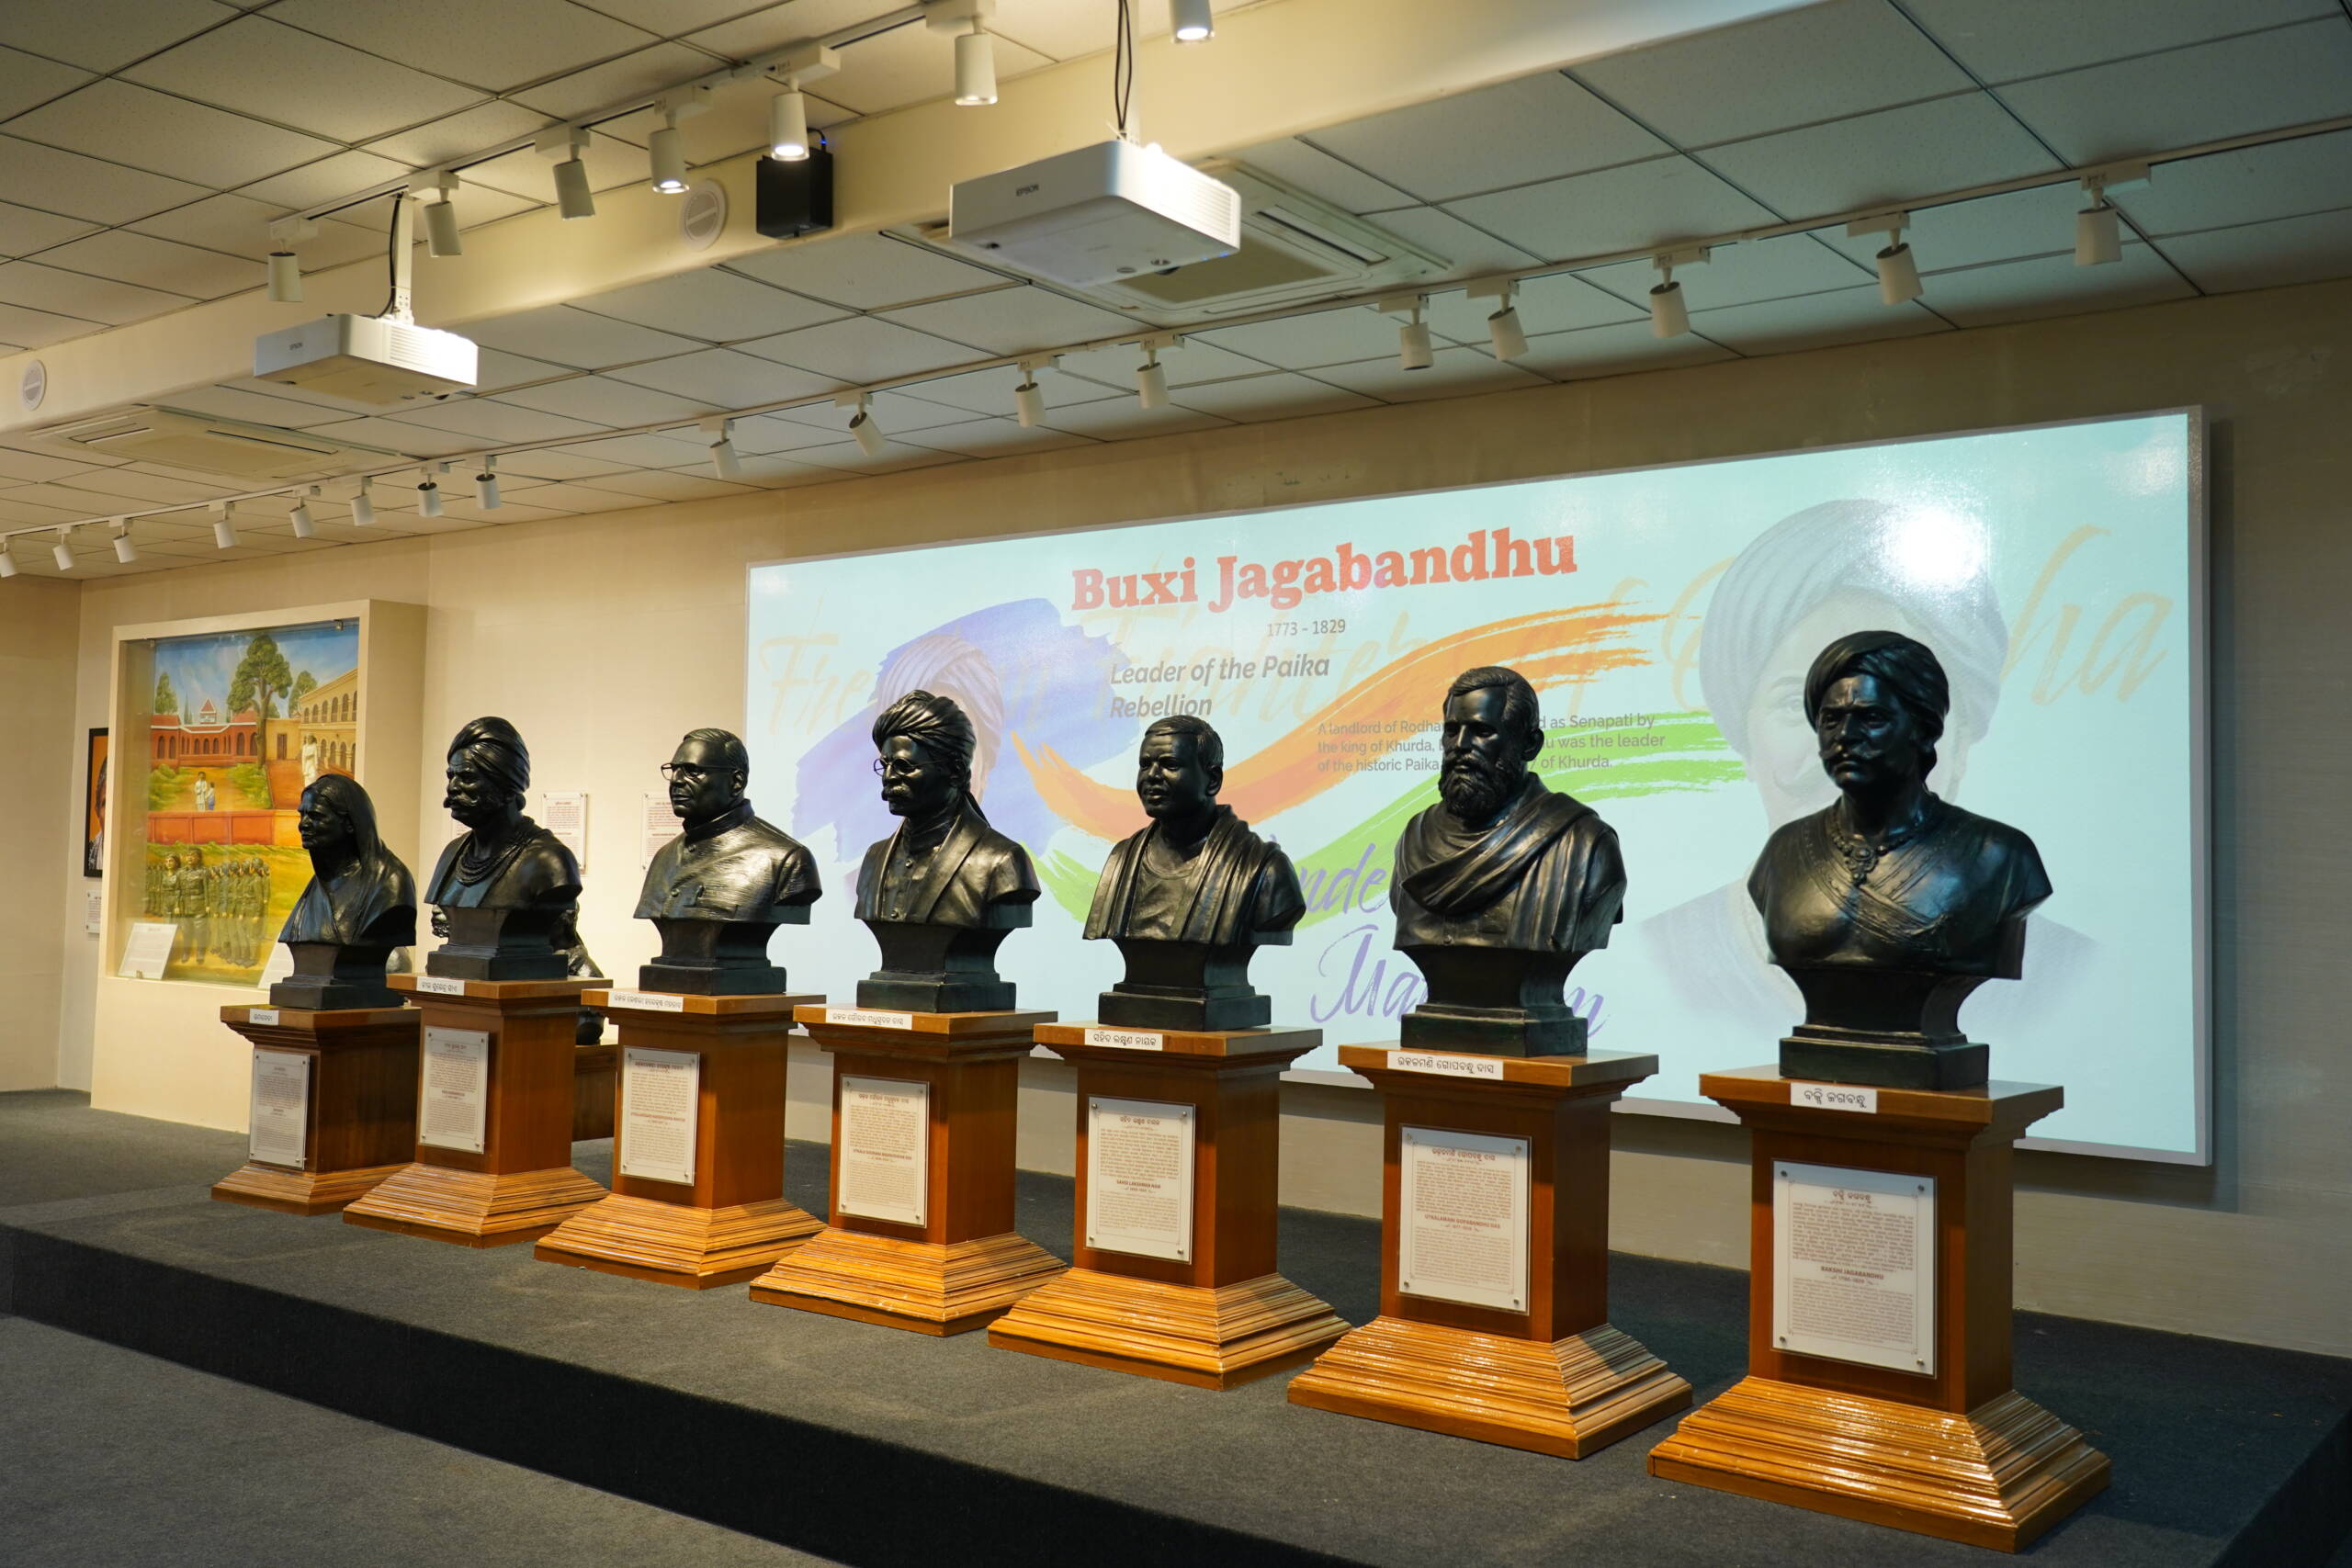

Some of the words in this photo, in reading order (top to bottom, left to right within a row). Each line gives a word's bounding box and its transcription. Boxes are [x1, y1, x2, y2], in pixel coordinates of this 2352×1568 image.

[1071, 557, 1198, 611] Buxi
[1208, 527, 1577, 613] Jagabandhu
[1267, 622, 1297, 637] 1773
[1312, 618, 1346, 635] 1829
[1110, 660, 1186, 684] Leader
[1191, 658, 1216, 687] of
[1219, 658, 1256, 680] the
[1261, 653, 1329, 678] Paika
[1110, 694, 1213, 718] Rebellion
[1317, 723, 1327, 735] A
[1329, 721, 1381, 735] landlord
[1384, 720, 1396, 734] of
[1550, 718, 1566, 728] as
[1569, 713, 1633, 730] Senapati
[1636, 713, 1655, 730] by
[1318, 741, 1338, 753] the
[1340, 740, 1367, 755] king
[1370, 739, 1384, 752] of
[1557, 739, 1586, 749] was
[1590, 735, 1613, 748] the
[1617, 732, 1666, 748] leader
[1317, 760, 1331, 772] of
[1333, 760, 1352, 772] the
[1356, 758, 1402, 772] historic
[1406, 758, 1440, 771] Paika
[1541, 754, 1556, 769] of
[1558, 754, 1613, 769] Khurda.
